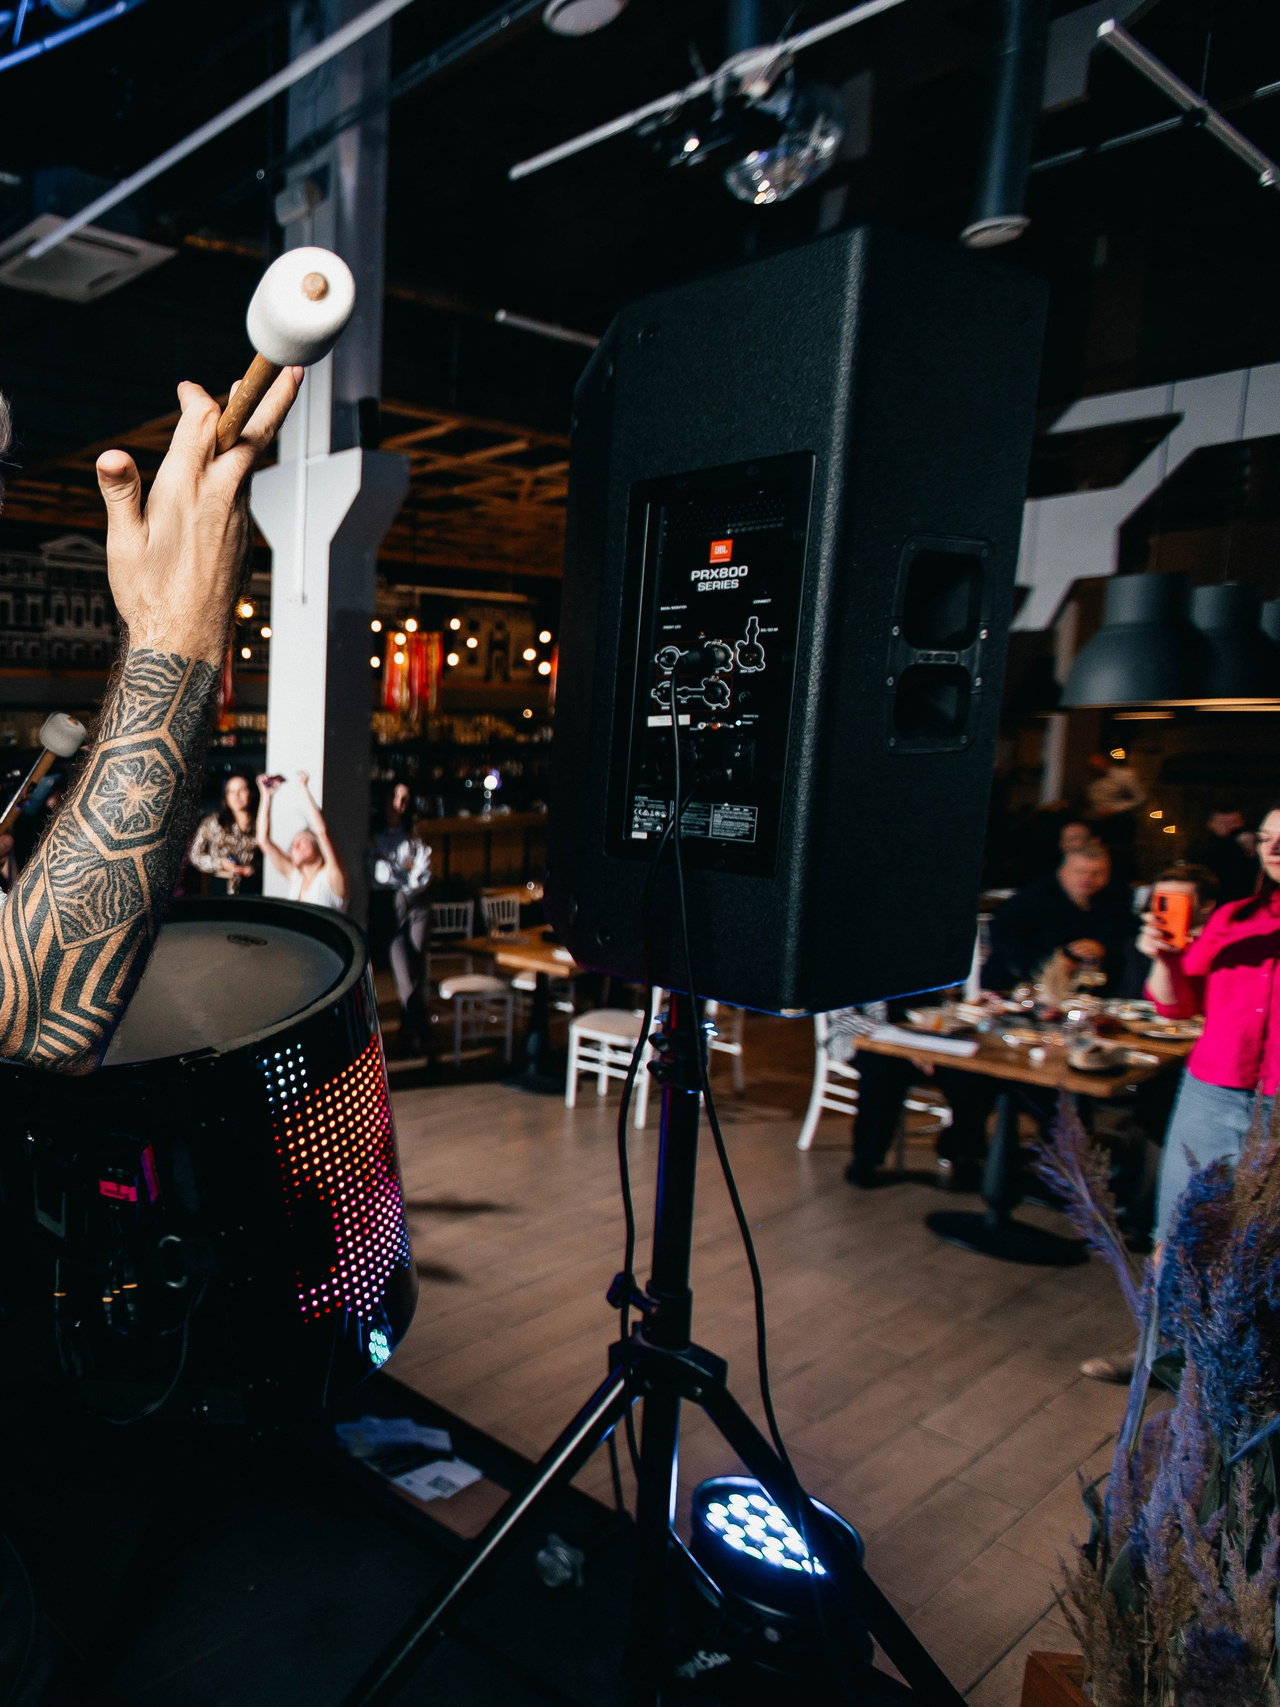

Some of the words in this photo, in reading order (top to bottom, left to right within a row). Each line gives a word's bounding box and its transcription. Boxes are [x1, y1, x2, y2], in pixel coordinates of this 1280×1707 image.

[714, 545, 728, 554] JBL
[690, 565, 749, 581] PRX800
[697, 579, 740, 592] SERIES
